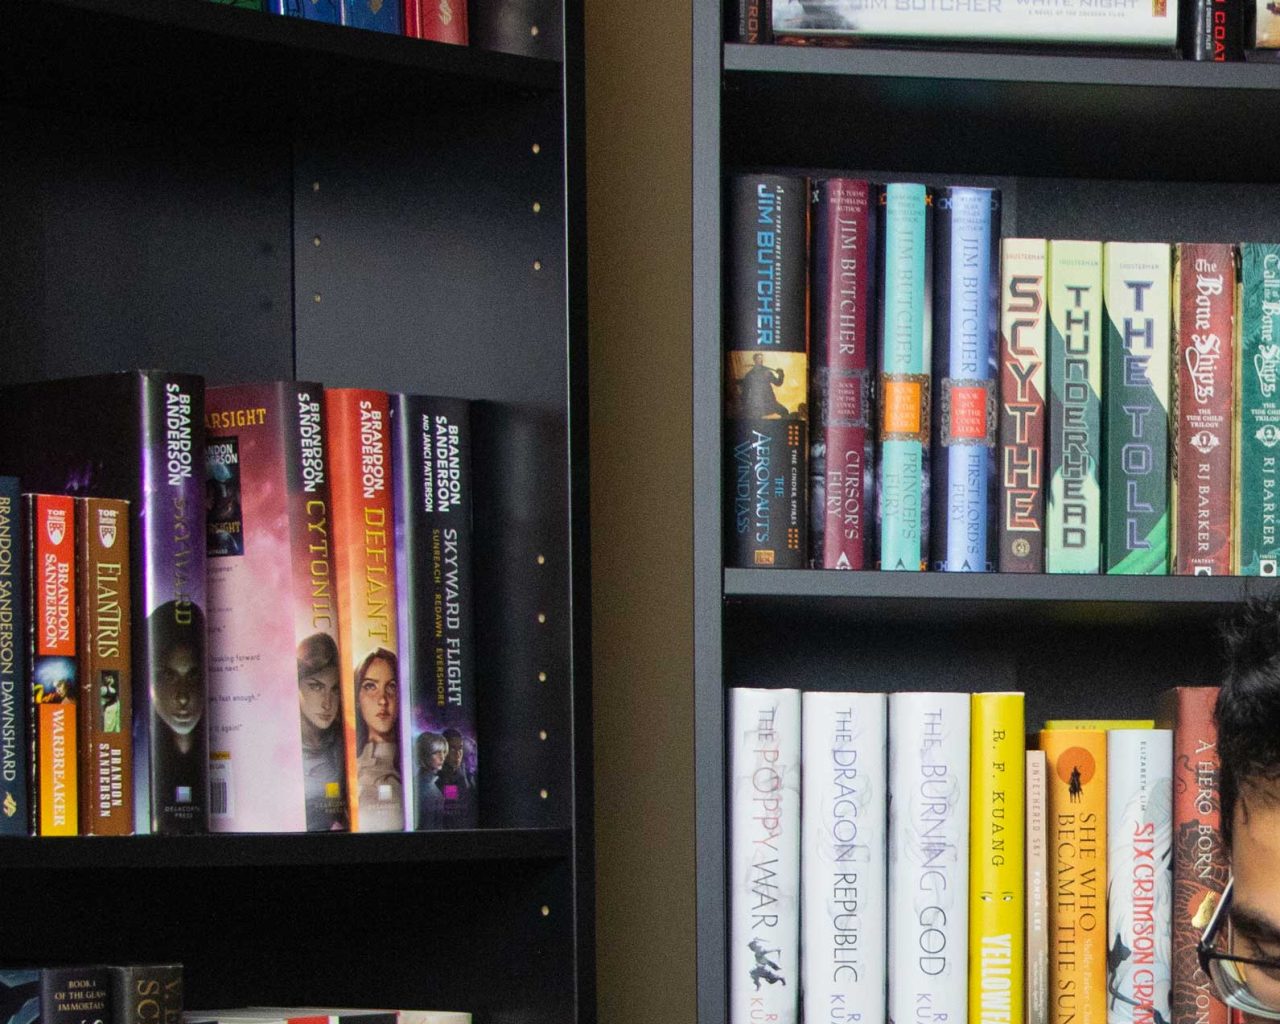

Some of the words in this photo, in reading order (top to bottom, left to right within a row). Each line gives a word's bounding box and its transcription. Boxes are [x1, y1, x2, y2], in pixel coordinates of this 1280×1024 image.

[757, 184, 775, 224] JIM
[838, 220, 856, 250] JIM
[757, 232, 775, 345] BUTCHER
[839, 259, 856, 355] BUTCHER
[1196, 275, 1223, 330] Bone
[1122, 280, 1153, 388] THE
[1185, 333, 1221, 403] Ships
[1254, 344, 1280, 398] Ships
[166, 383, 181, 486] SANDERSON
[179, 394, 192, 477] BRANDON
[298, 393, 316, 491] SANDERSON
[309, 402, 324, 483] BRANDON
[1006, 275, 1043, 533] SCYTHE
[1062, 286, 1090, 549] THUNDERHEAD
[360, 400, 374, 498] SANDERSON
[369, 411, 384, 492] BRANDON
[435, 416, 449, 512] SANDERSON
[447, 424, 461, 505] BRANDON
[1121, 404, 1152, 551] TOLL
[828, 470, 841, 518] FURY
[844, 450, 859, 540] CURSOR'S
[1198, 484, 1210, 551] BARKER
[1262, 478, 1275, 545] BARKER
[46, 553, 58, 648] SANDERSON
[58, 562, 69, 641] BRANDON
[305, 500, 332, 628] CYTONIC
[363, 506, 391, 643] DEFIANT
[443, 528, 460, 630] SKYWARD
[97, 562, 121, 658] ELANTRIS
[446, 638, 462, 706] FLIGHT
[2, 681, 16, 781] DAWNSHARD
[758, 707, 776, 742] THE
[835, 708, 852, 742] THE
[923, 708, 942, 747] THE
[52, 708, 65, 826] WARBREAKER
[753, 750, 782, 851] POPPY
[833, 750, 857, 862] DRAGON
[1197, 761, 1214, 815] HERO
[919, 764, 947, 891] BURNING
[992, 791, 1006, 867] KUANG
[1058, 814, 1075, 913] BECAME
[1079, 812, 1097, 860] SHE
[1193, 824, 1212, 879] BORN
[752, 858, 779, 930] WAR
[833, 873, 858, 983] REPUBLIC
[1079, 867, 1097, 932] WHO
[919, 906, 946, 975] GOD
[1058, 922, 1076, 972] THE
